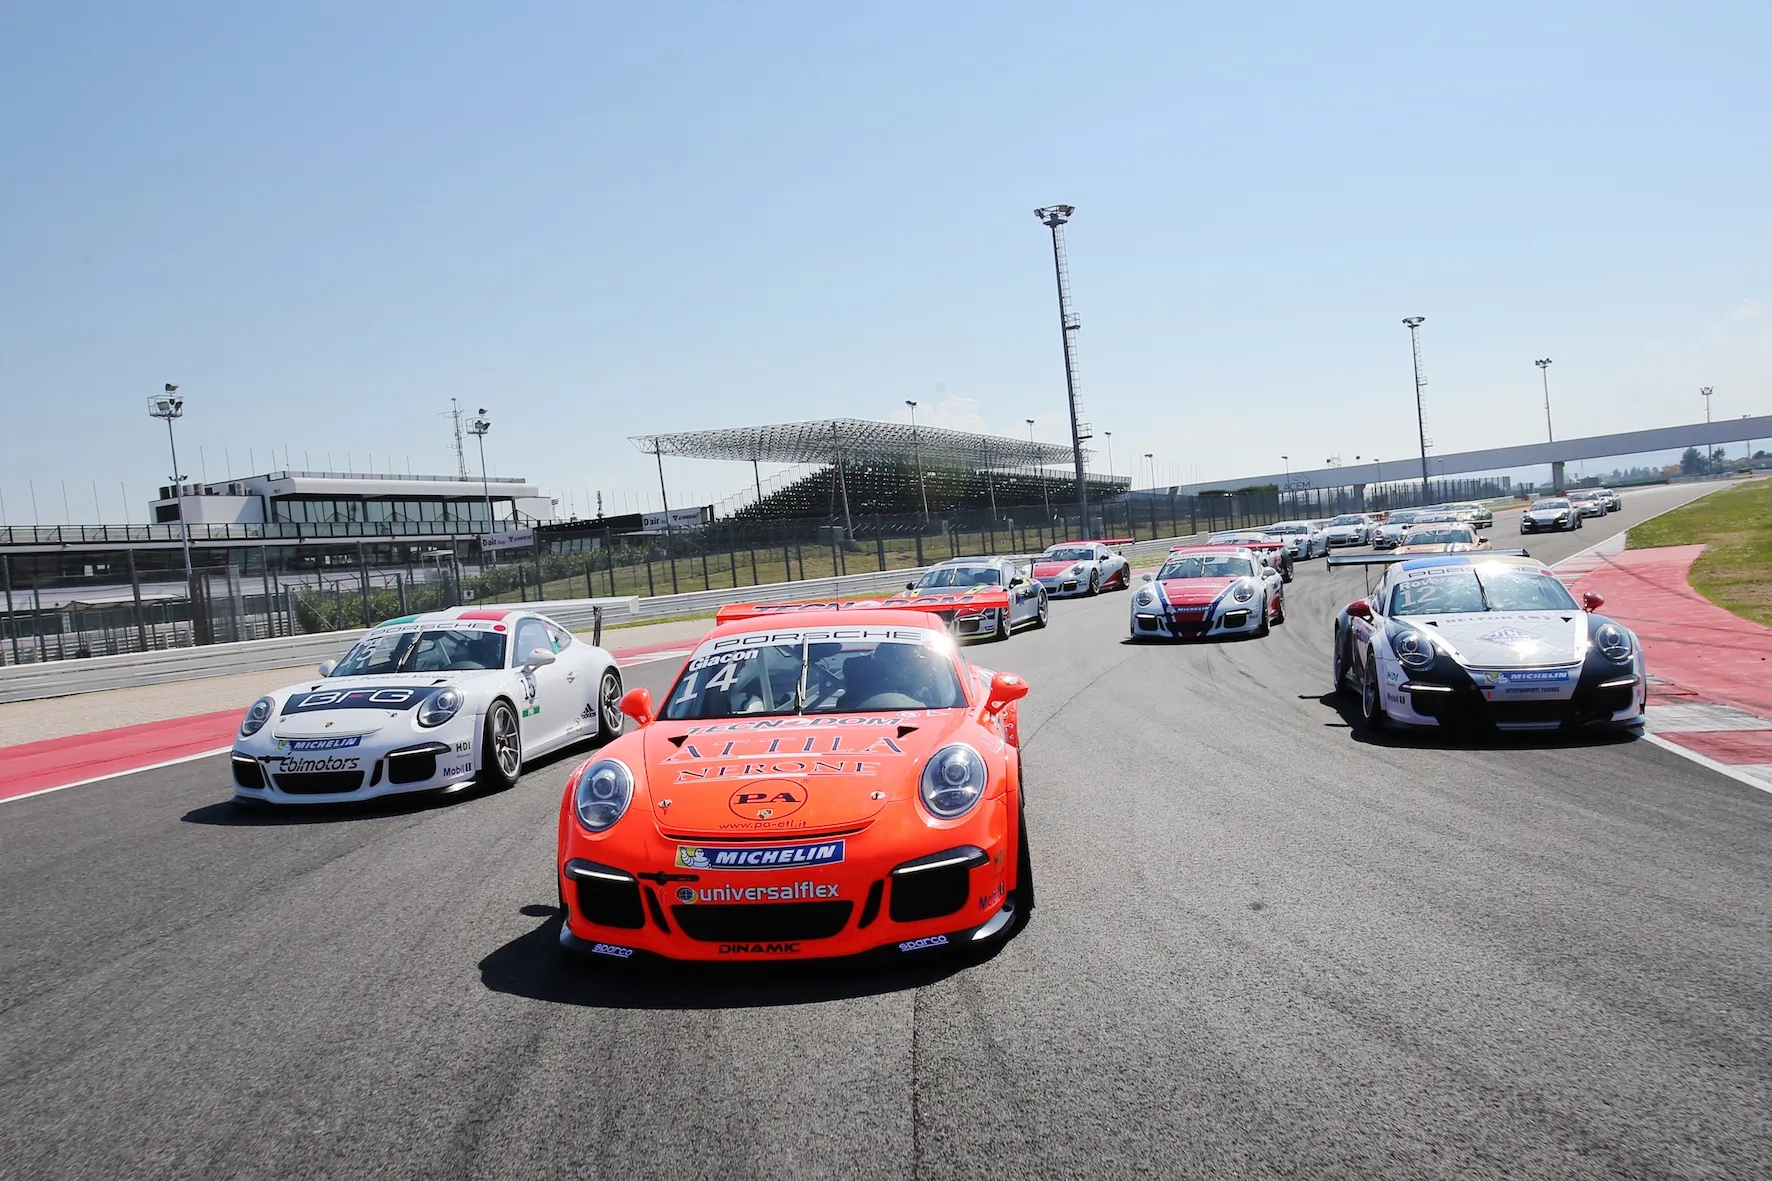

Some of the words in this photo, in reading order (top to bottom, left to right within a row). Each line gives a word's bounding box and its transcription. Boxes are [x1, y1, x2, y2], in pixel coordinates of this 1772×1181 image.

[1409, 566, 1539, 578] PORHE
[1400, 586, 1436, 607] 12
[371, 623, 492, 636] PORSCHE
[714, 630, 922, 650] PORSCHE
[340, 645, 376, 667] 15
[688, 649, 759, 672] Giacon
[1510, 671, 1567, 680] MICHELIN
[675, 663, 739, 704] 14
[1387, 692, 1399, 704] Mobil
[294, 737, 358, 750] MICHELIN
[456, 741, 471, 752] HDI
[665, 735, 905, 761] ATTILA
[443, 764, 465, 776] Mobil
[676, 761, 881, 781] NERONE
[734, 792, 802, 806] PA
[715, 844, 837, 865] MICHELIN
[699, 881, 839, 902] universalflex
[592, 943, 633, 958] sparco
[718, 942, 803, 954] DINAMIC
[899, 935, 948, 951] sparco
